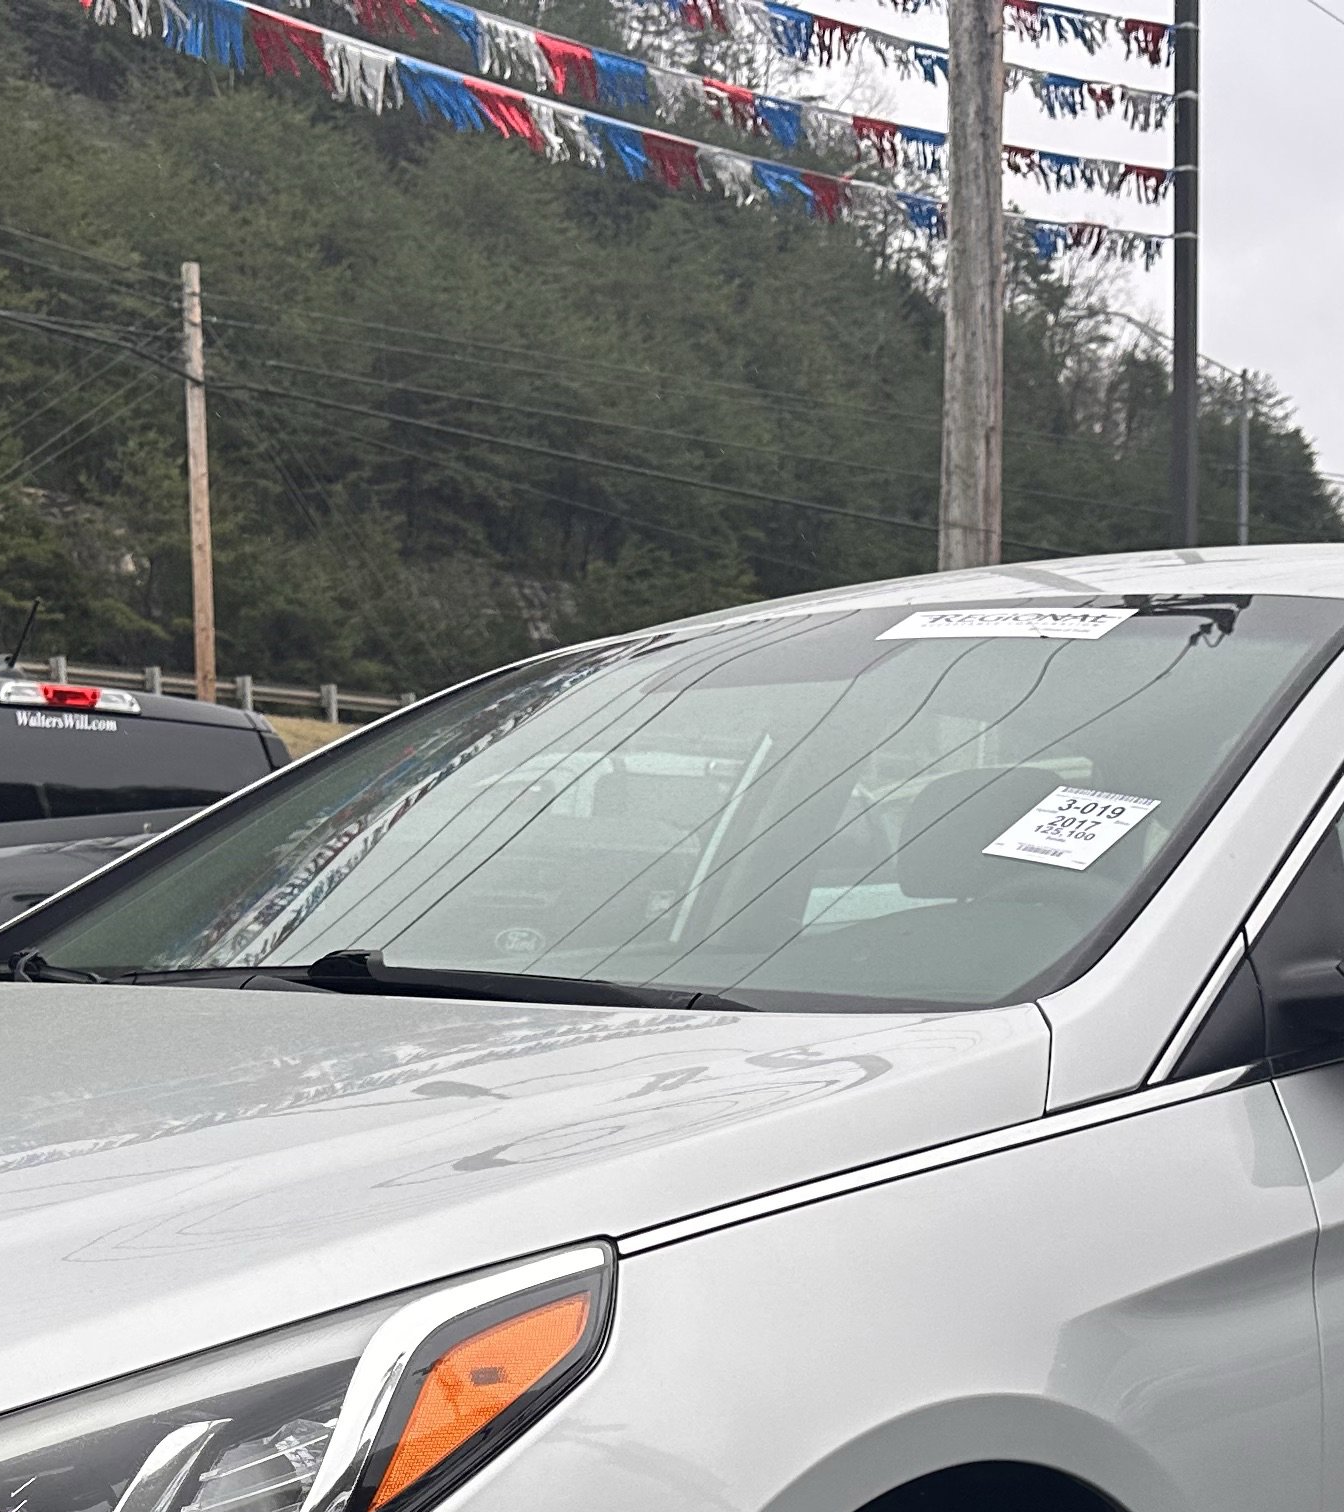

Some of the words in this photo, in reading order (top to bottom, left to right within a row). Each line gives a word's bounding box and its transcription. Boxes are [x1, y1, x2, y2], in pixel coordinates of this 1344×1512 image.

[16, 710, 117, 732] WaltersWill.com
[1058, 799, 1126, 820] 3-019
[1034, 824, 1096, 841] 125,100
[1047, 815, 1102, 832] 2017
